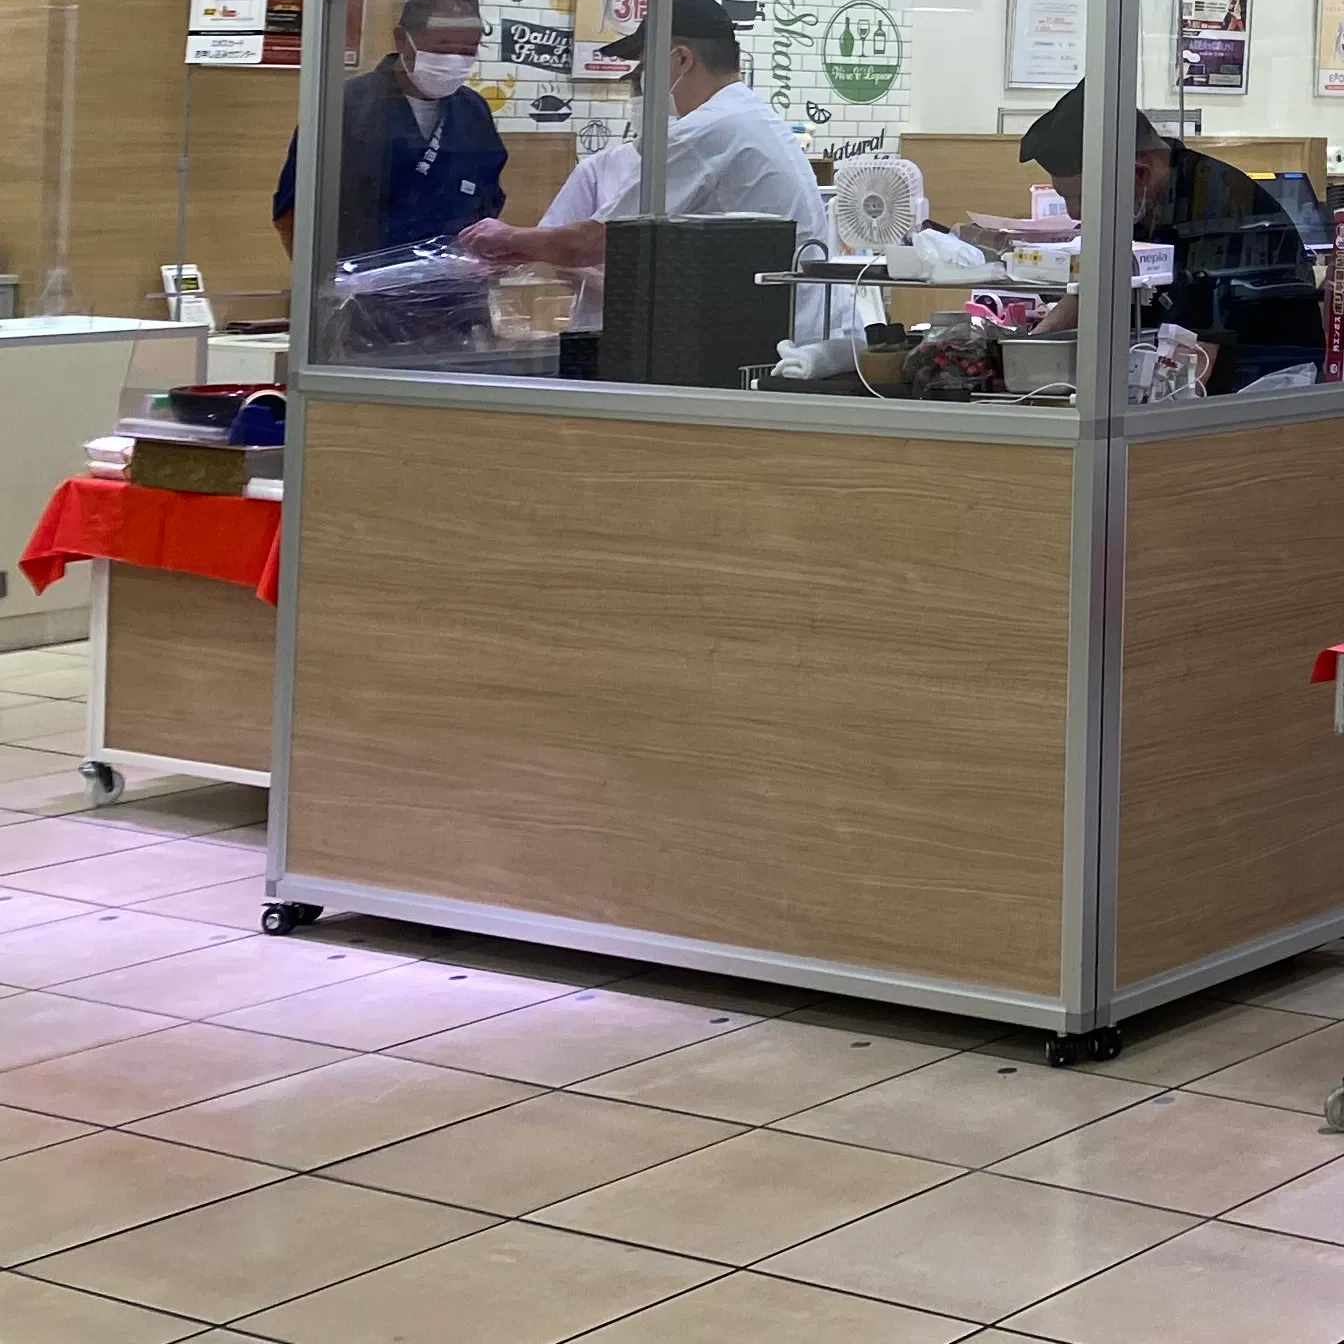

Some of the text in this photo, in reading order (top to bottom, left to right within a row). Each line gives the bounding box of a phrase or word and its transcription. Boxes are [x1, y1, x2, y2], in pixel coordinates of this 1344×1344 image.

[511, 24, 568, 54] Daily
[823, 128, 885, 161] Natural
[1139, 252, 1168, 265] nepia
